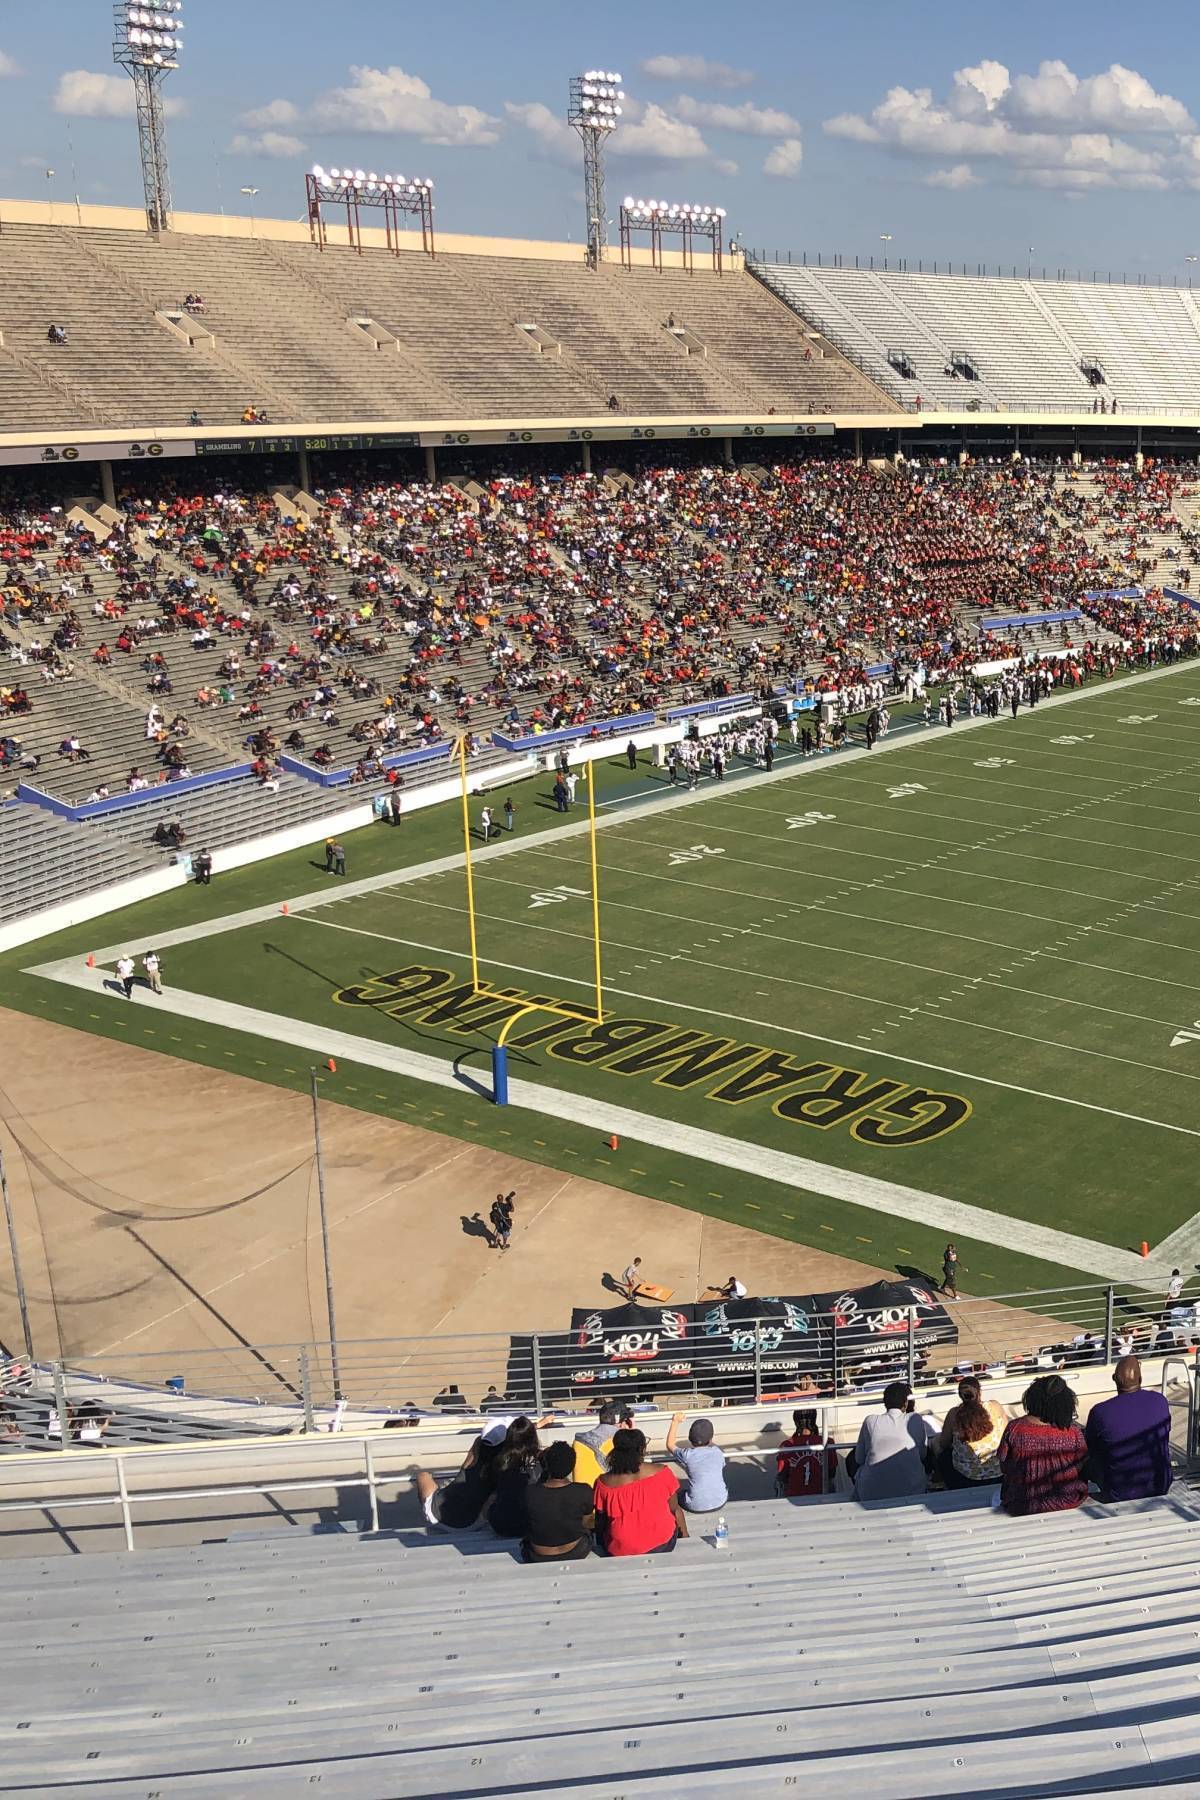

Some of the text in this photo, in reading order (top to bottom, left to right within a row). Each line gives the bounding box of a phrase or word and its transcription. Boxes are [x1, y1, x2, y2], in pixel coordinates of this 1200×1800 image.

[249, 442, 255, 451] 7
[305, 439, 326, 449] 5:20
[892, 782, 928, 796] 40
[790, 811, 836, 827] 30
[672, 845, 725, 862] 20
[532, 885, 591, 903] 10
[332, 965, 973, 1148] GRAMBLING
[804, 1461, 810, 1485] 1
